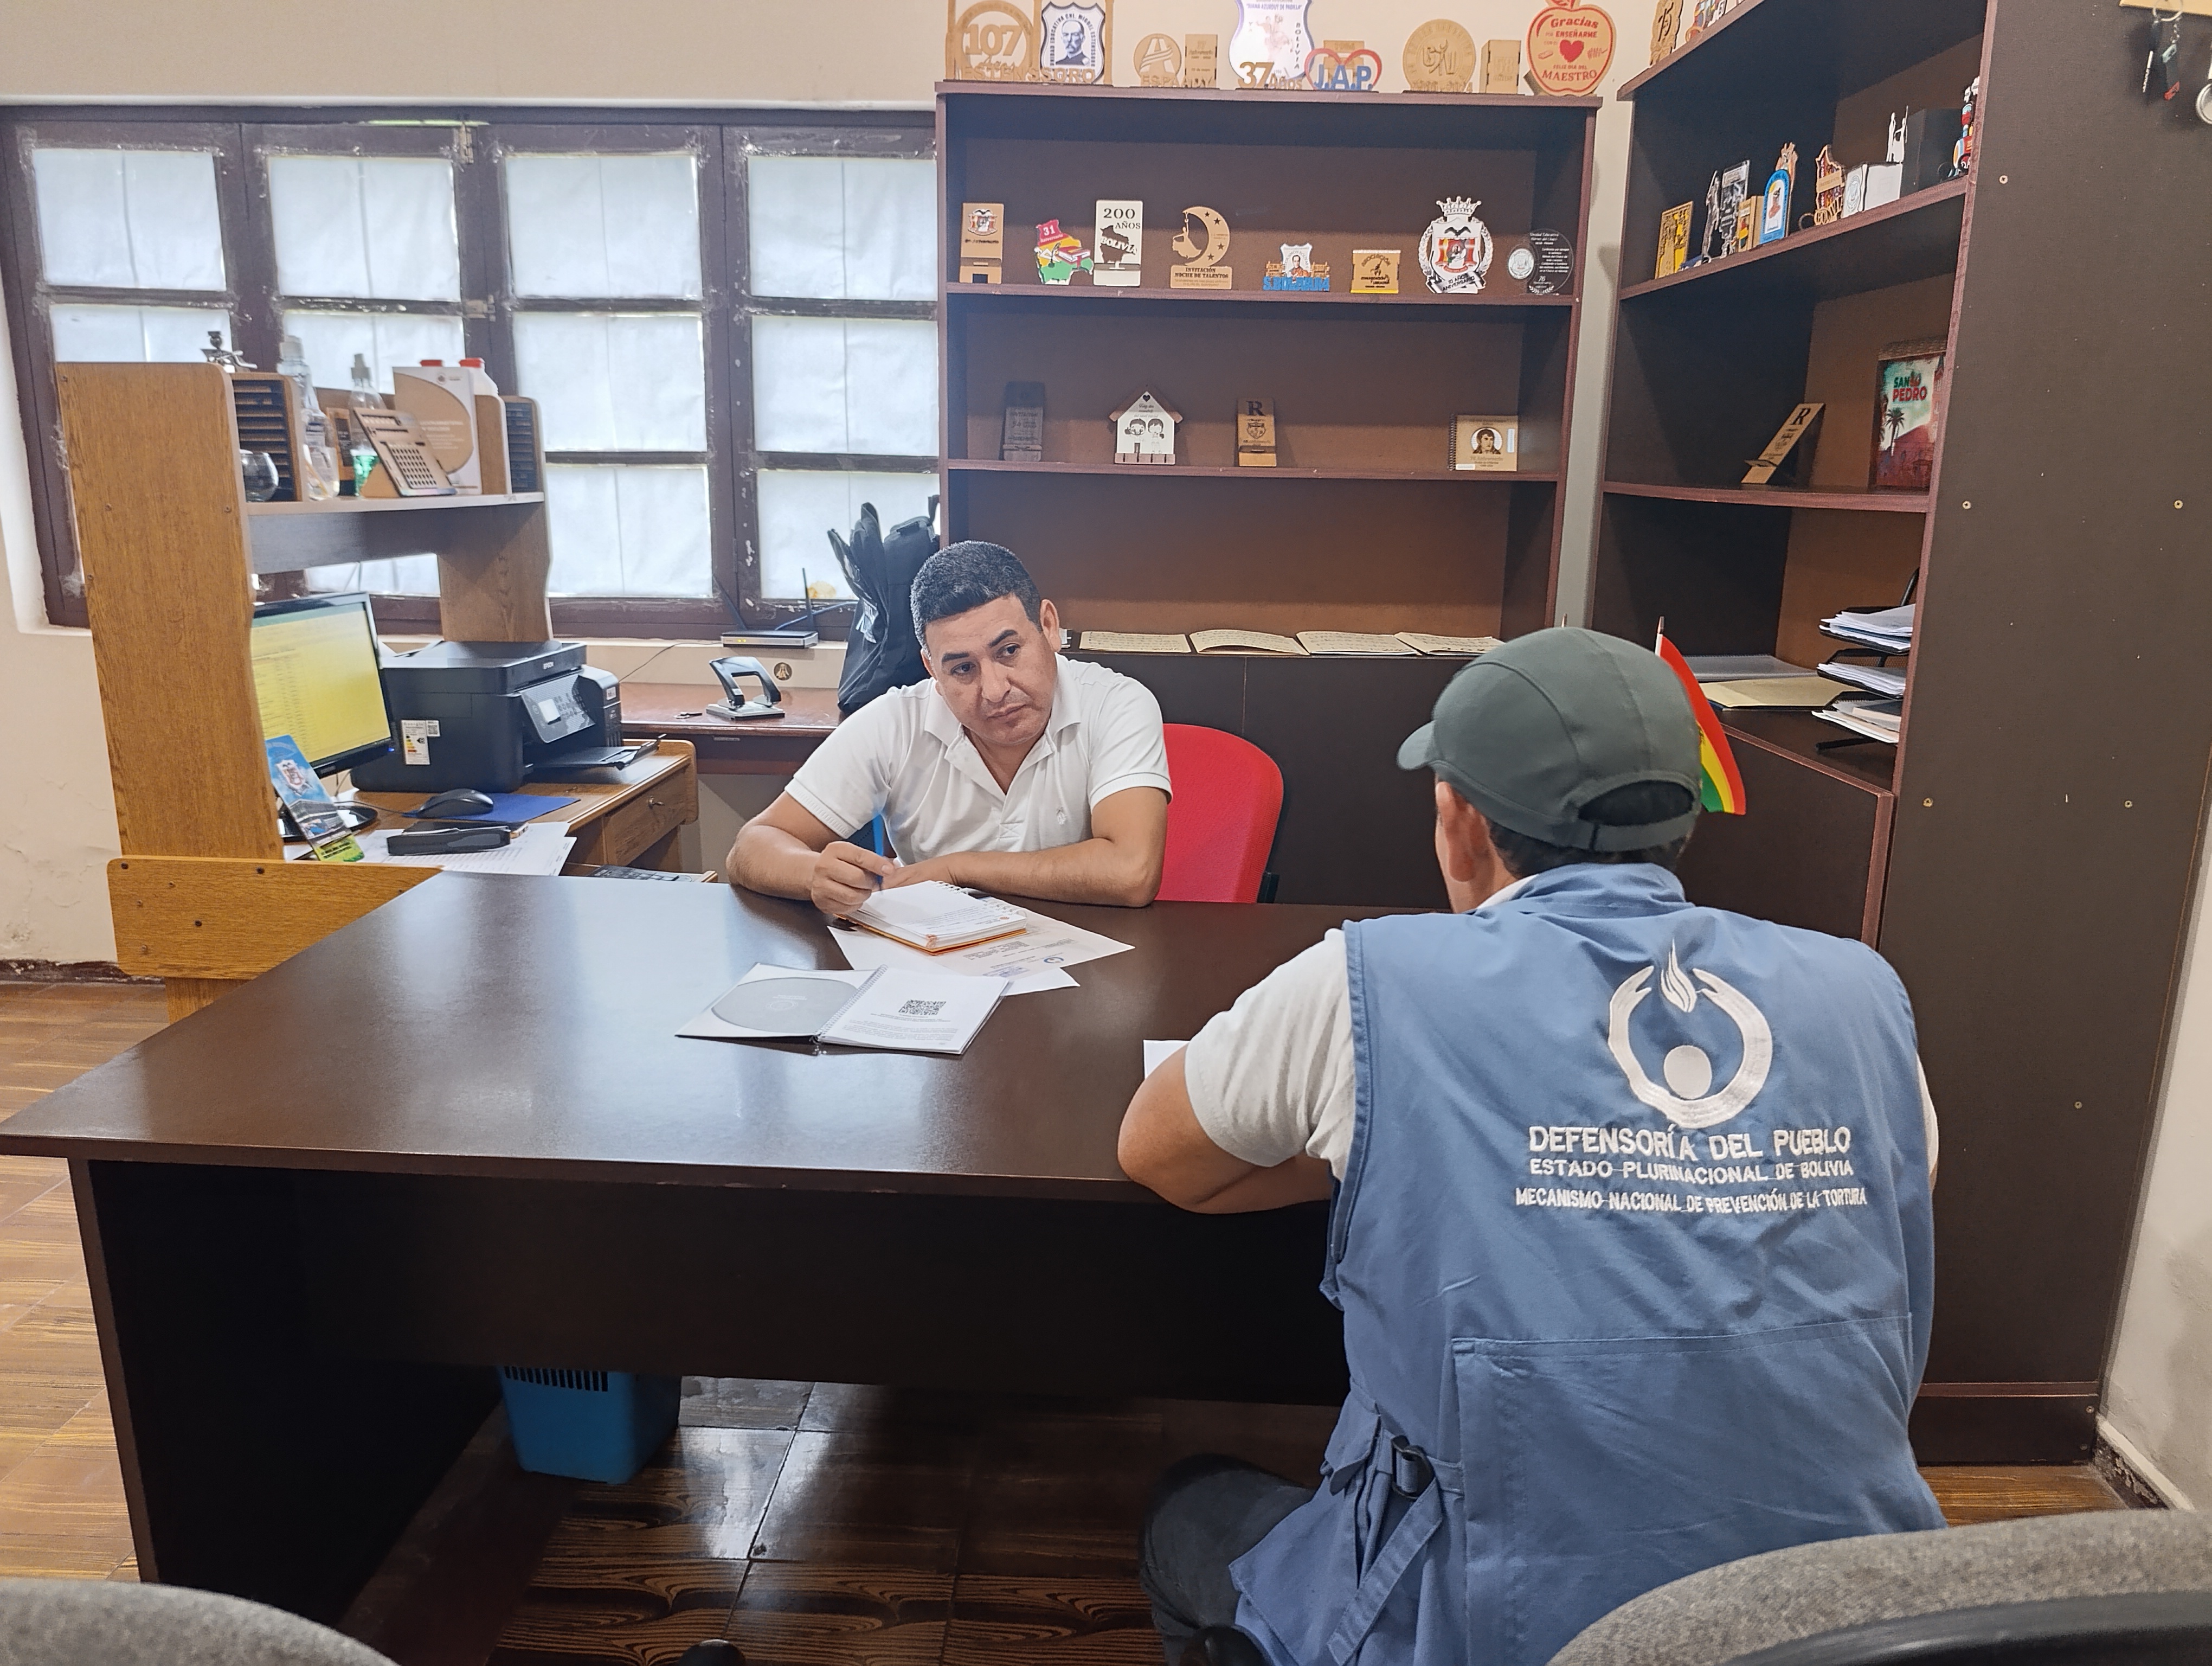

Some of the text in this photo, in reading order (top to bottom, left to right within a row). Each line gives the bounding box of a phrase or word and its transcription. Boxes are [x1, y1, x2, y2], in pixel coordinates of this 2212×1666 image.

[1551, 16, 1599, 29] Gracias
[965, 24, 1024, 56] 107
[1555, 29, 1598, 38] ENSEÑARME
[963, 66, 1095, 82] ESTENSSORO
[1239, 62, 1274, 88] 37
[1314, 64, 1373, 90] J.A.P.
[1542, 69, 1598, 82] MAESTRO
[1104, 208, 1135, 219] 200
[1043, 226, 1055, 236] 31
[1115, 221, 1141, 230] AÑOS
[1443, 275, 1475, 291] ANIVERSARIO
[1455, 273, 1468, 282] AÑOS
[1894, 376, 1910, 388] SAN
[1892, 386, 1927, 402] PEDRO
[1246, 400, 1265, 416] R
[1792, 408, 1810, 425] R
[1529, 1125, 1850, 1161] DEFENSORÍA DEL PUEBLO
[1530, 1158, 1854, 1185] ESTADO PLURINACIONAL DE BOLIVIA
[1516, 1187, 1867, 1214] MECANISMO NACIONAL DE PREVENCIÓN DE LA TORTURA
